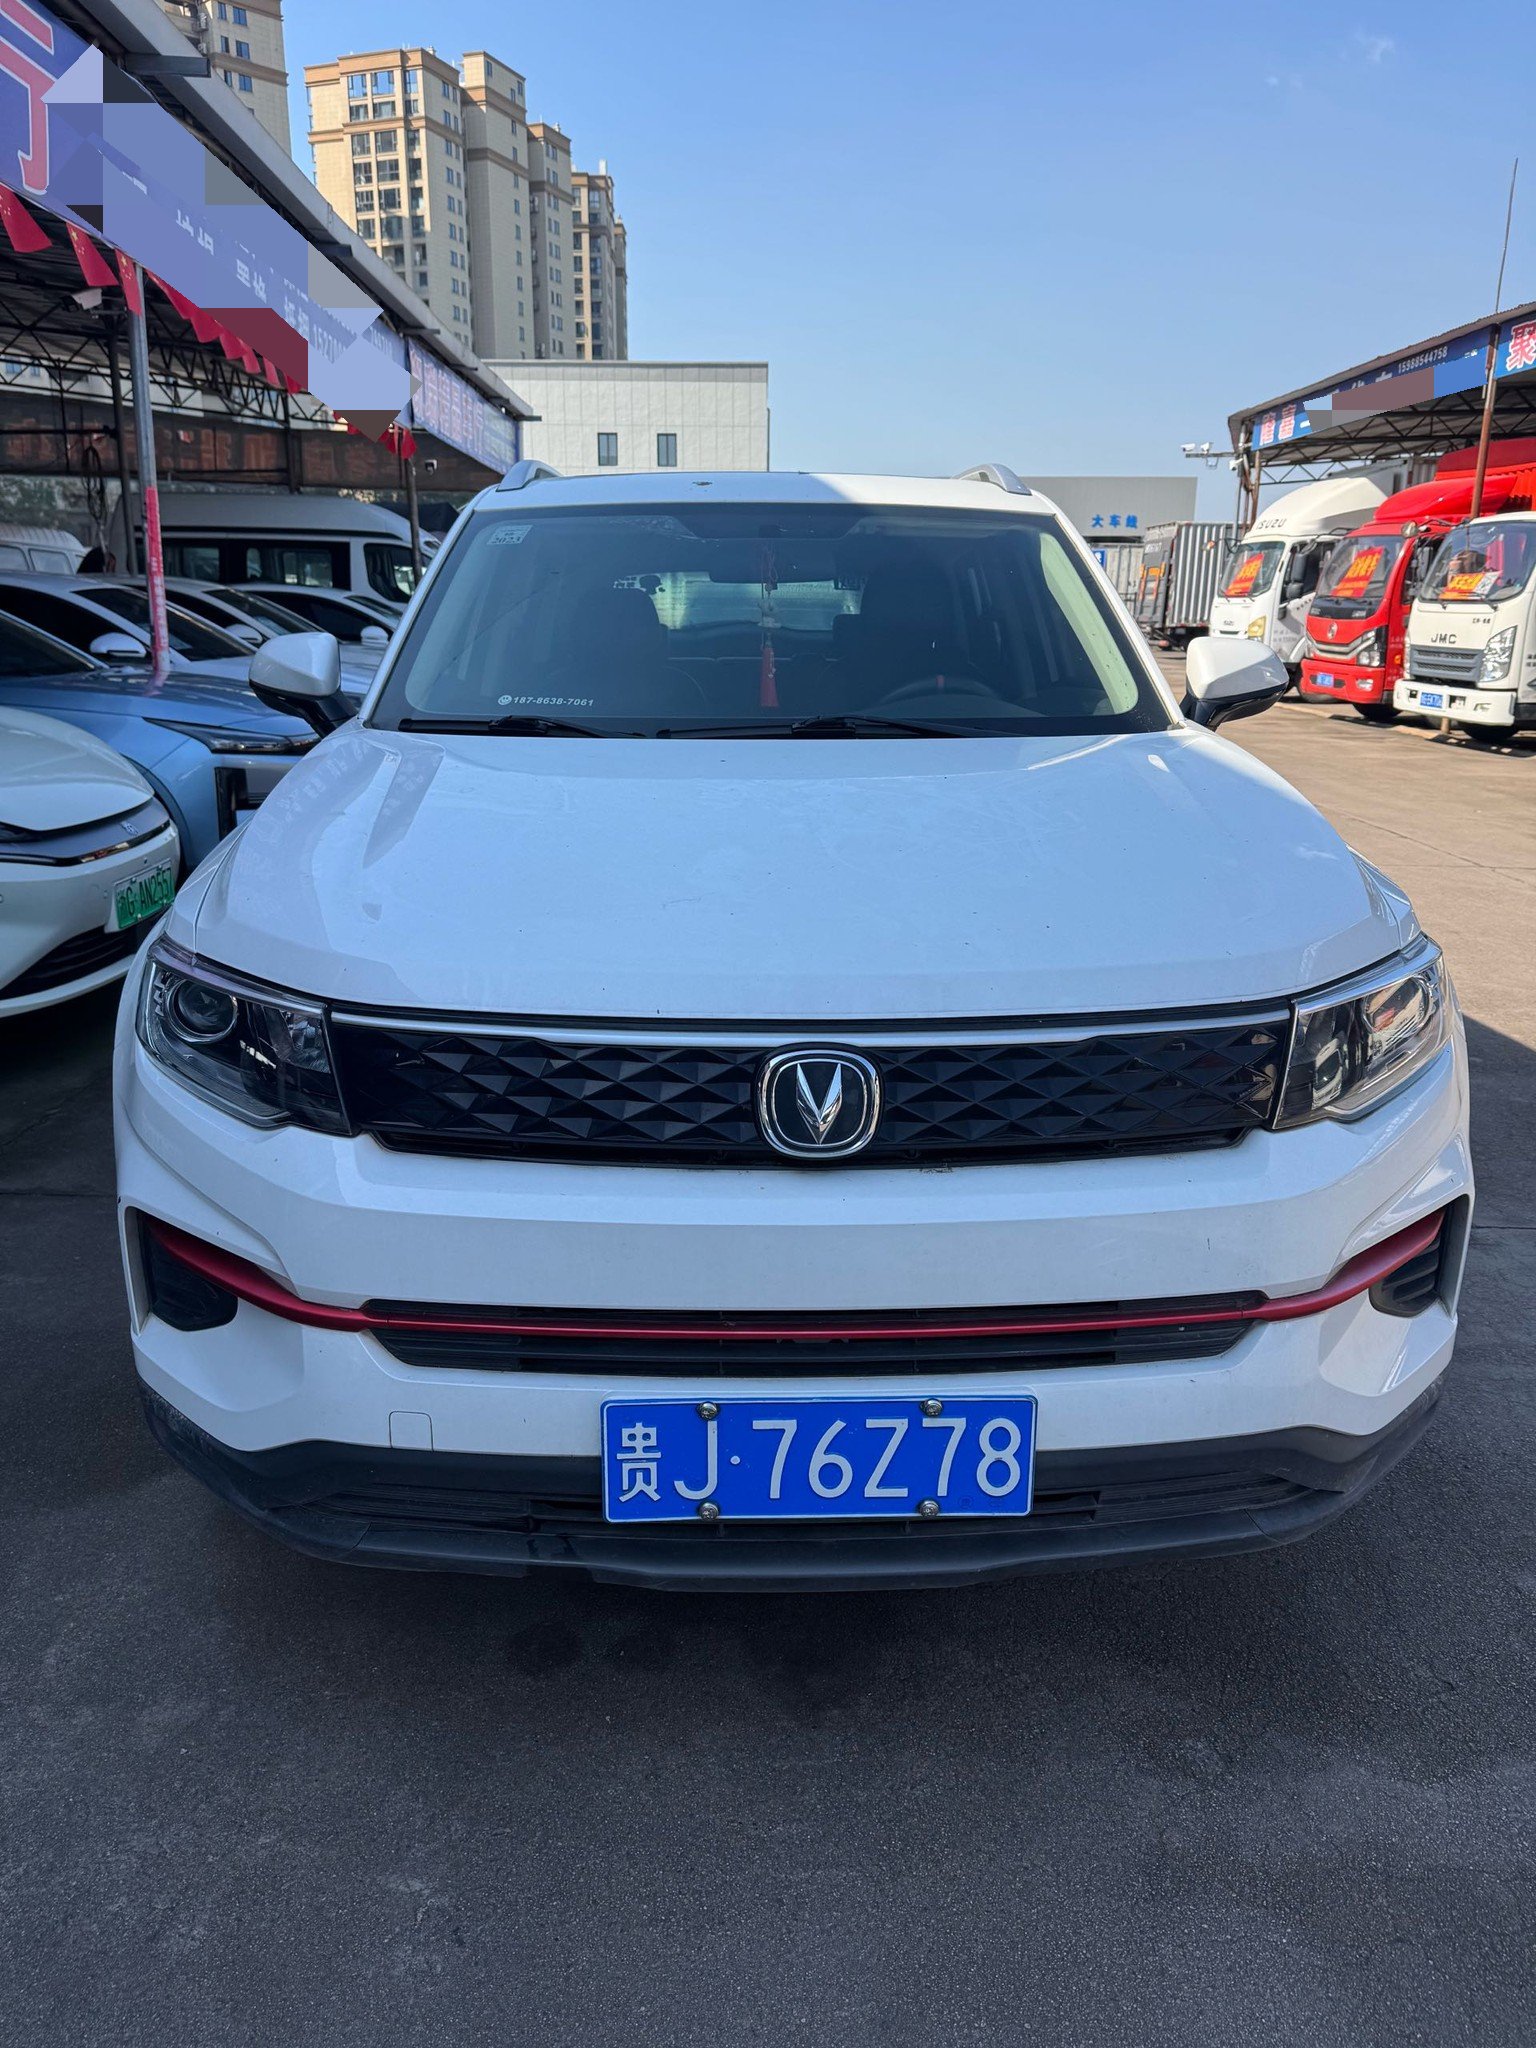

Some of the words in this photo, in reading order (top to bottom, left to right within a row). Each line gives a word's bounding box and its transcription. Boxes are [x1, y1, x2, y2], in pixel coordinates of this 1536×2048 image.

[1256, 518, 1287, 530] ISUZU
[1430, 633, 1457, 645] JMC
[513, 696, 594, 707] 187-8638-7061
[618, 1416, 1022, 1503] 贵J·76Z78
